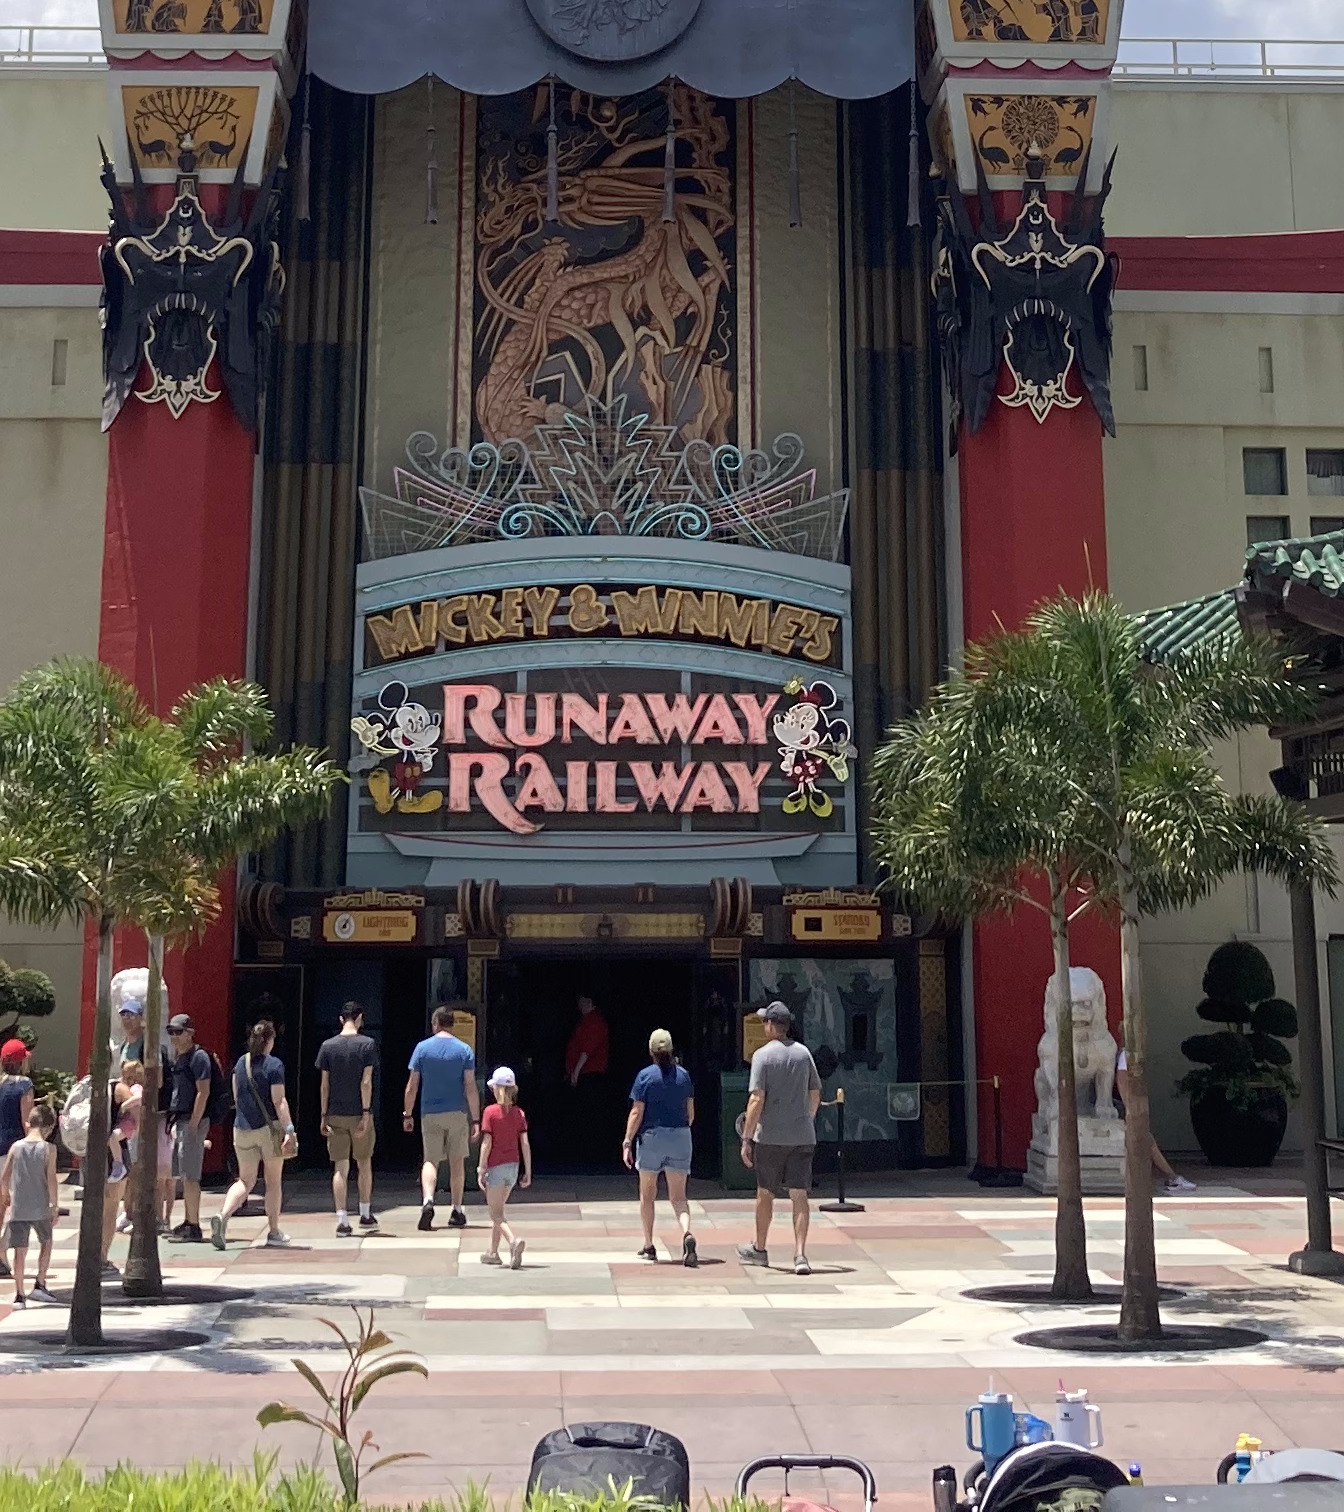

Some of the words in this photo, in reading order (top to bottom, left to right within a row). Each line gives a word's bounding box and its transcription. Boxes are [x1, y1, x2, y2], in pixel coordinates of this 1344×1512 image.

[367, 586, 560, 660] MICKEY
[568, 584, 610, 633] &
[610, 585, 839, 661] MINNIE'S
[442, 684, 781, 750] RUNAWAY
[448, 752, 773, 835] RAILWAY
[362, 915, 409, 928] LIGHTNING
